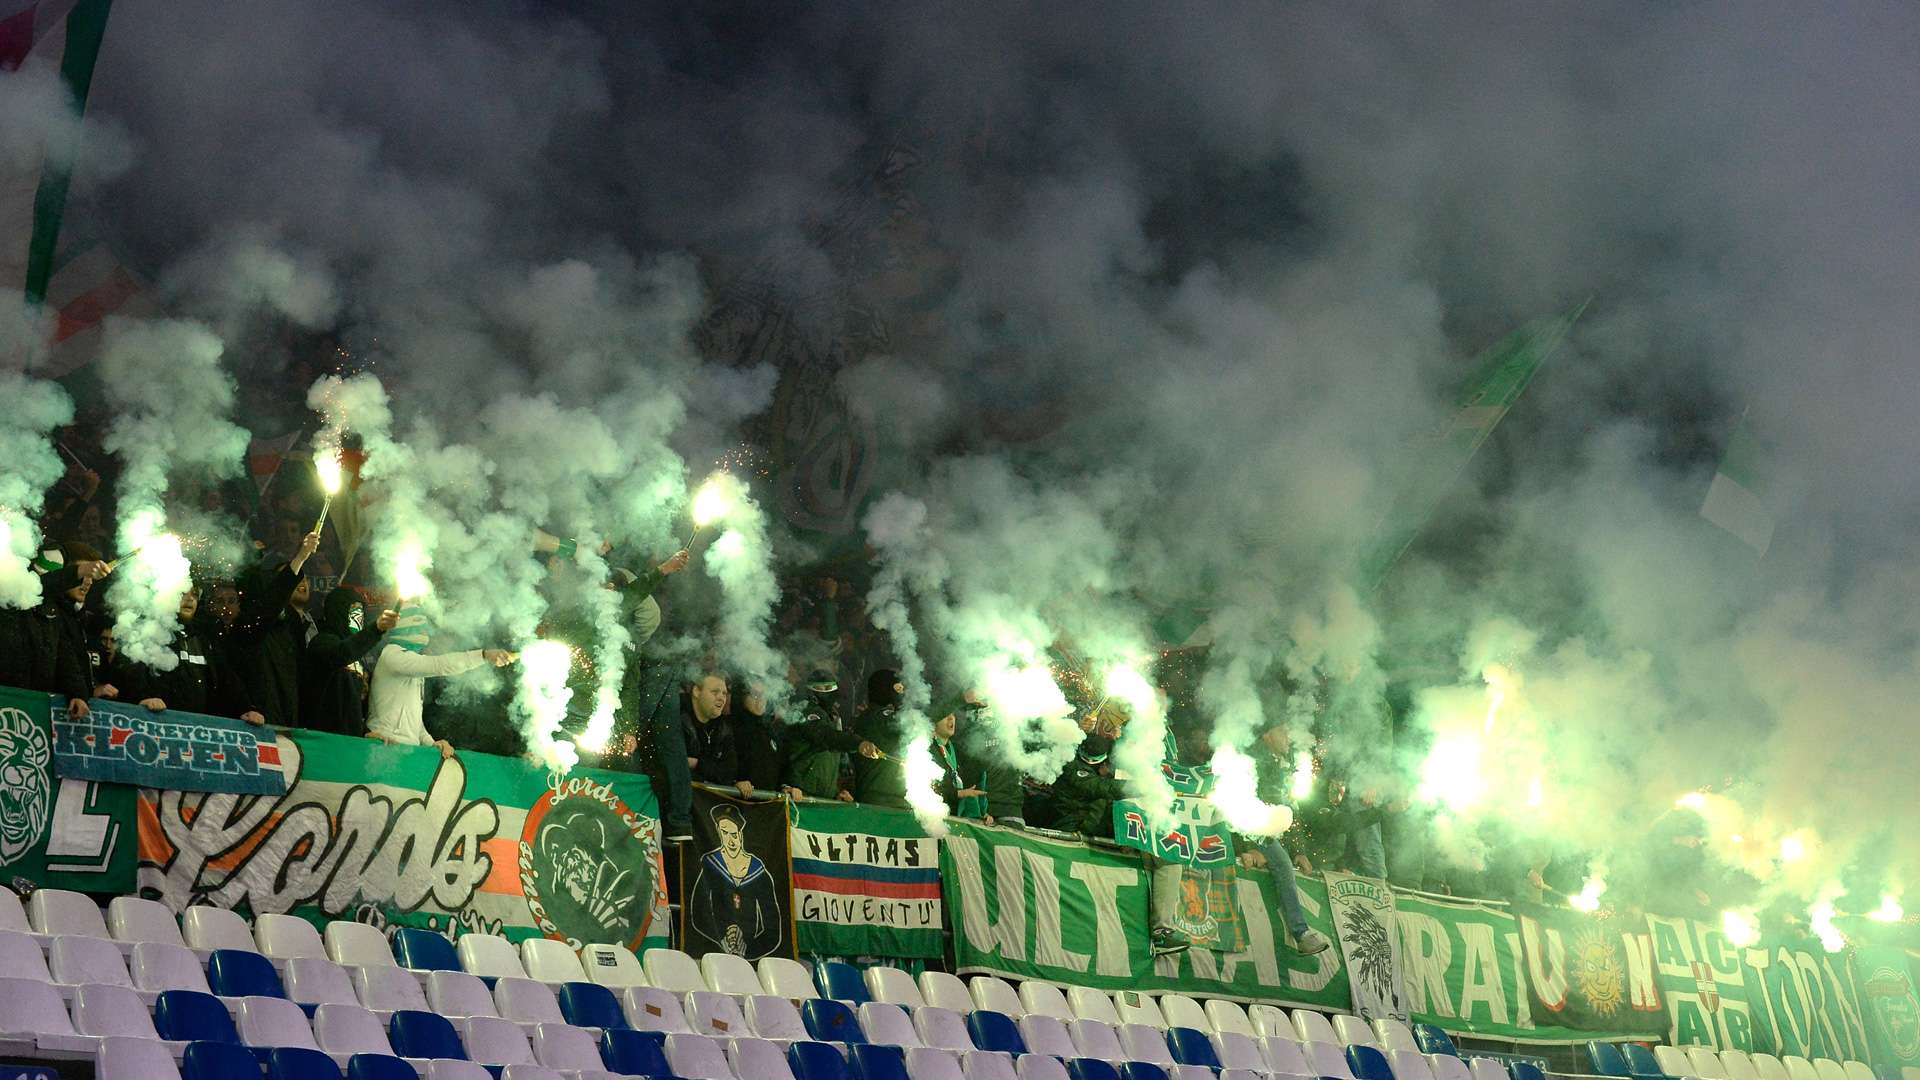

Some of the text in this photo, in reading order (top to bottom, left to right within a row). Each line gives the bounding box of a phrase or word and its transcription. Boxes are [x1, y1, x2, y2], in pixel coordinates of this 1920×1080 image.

[52, 722, 260, 776] KLOTEN
[547, 772, 619, 810] Lords
[806, 832, 920, 867] ULTRAS
[519, 840, 558, 934] since
[1336, 882, 1384, 902] ULTRAS
